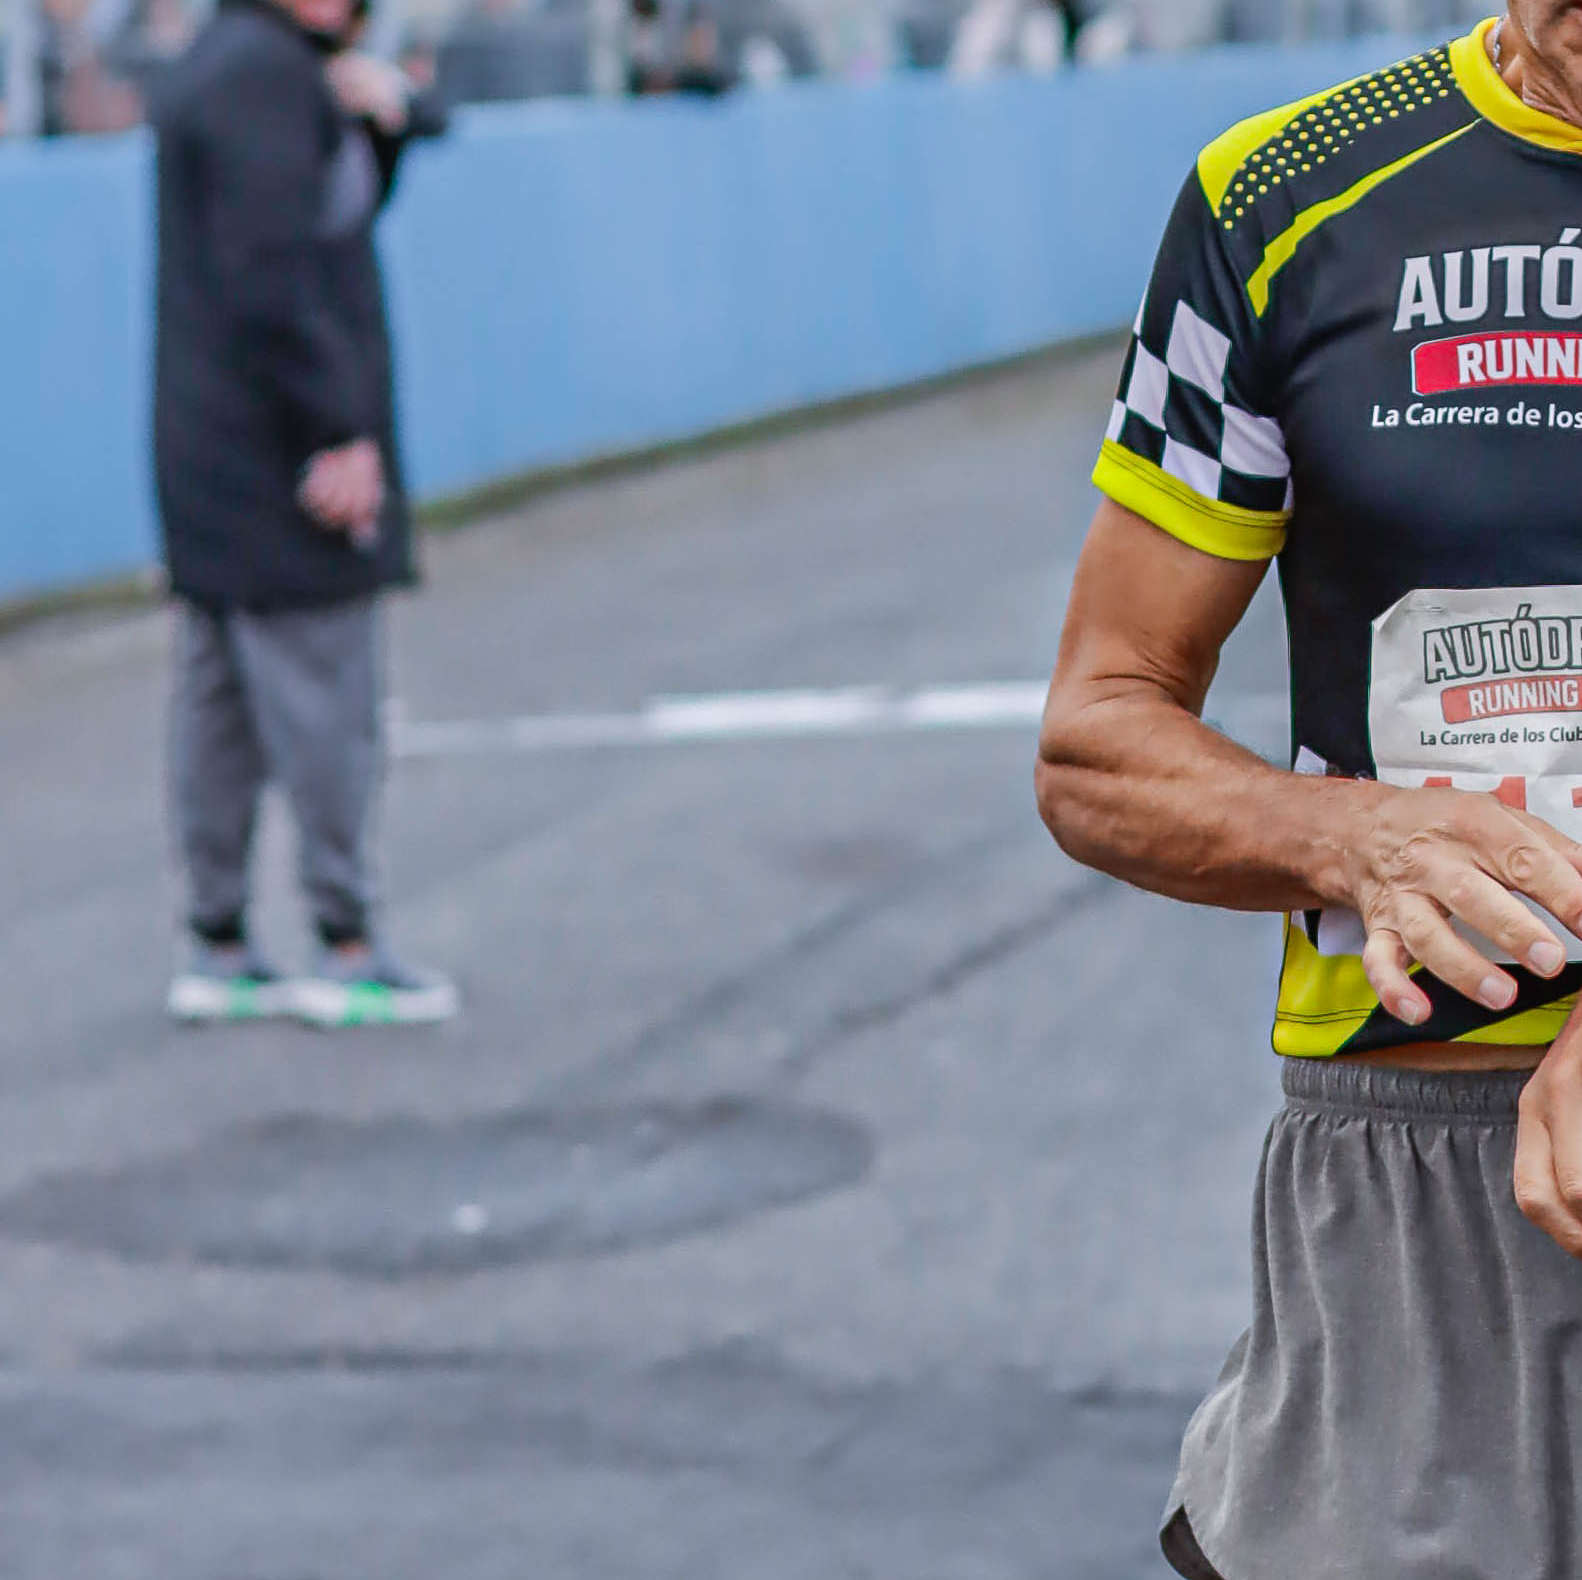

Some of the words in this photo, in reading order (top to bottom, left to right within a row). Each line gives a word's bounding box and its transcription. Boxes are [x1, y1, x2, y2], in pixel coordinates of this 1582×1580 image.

[1372, 404, 1399, 427] La
[1406, 402, 1500, 426] Carrera
[1506, 401, 1541, 426] de
[1469, 681, 1579, 716] RUNNING
[1420, 730, 1437, 746] La
[1440, 729, 1496, 746] Carrera
[1500, 727, 1519, 744] de
[1523, 726, 1545, 743] los
